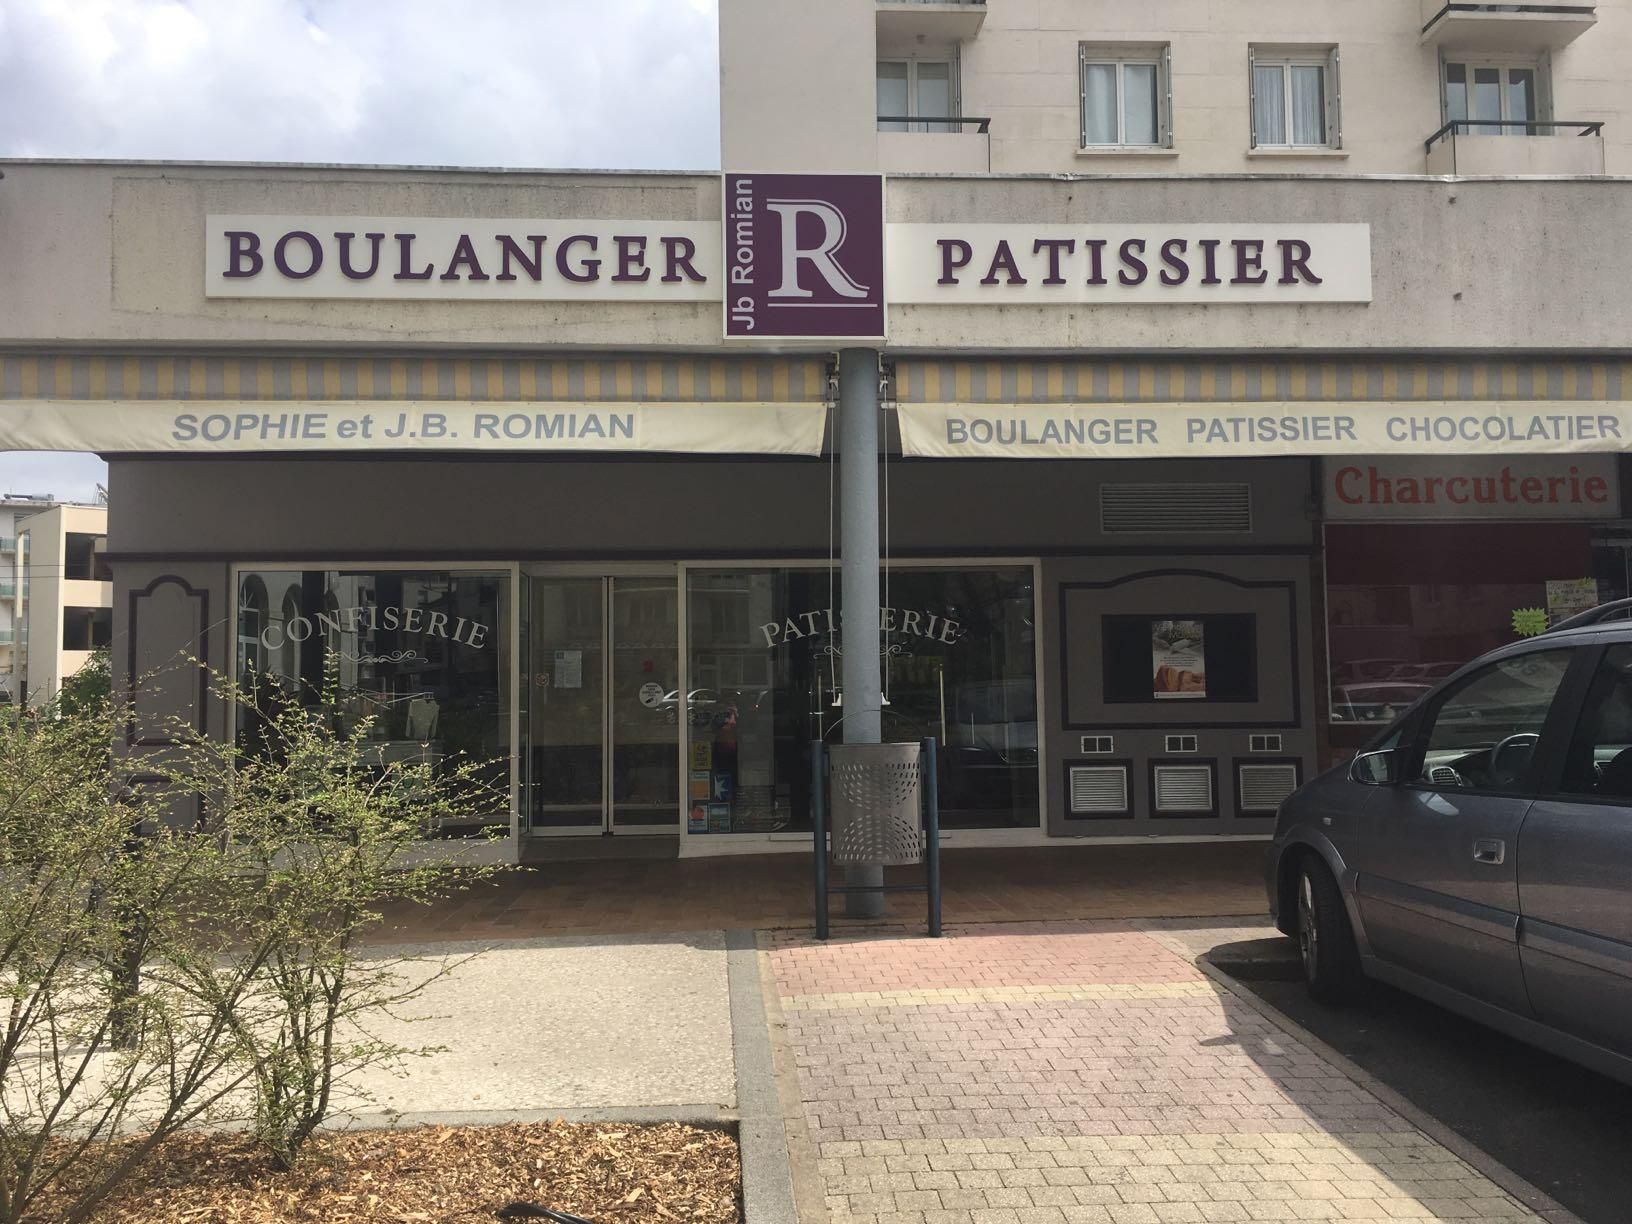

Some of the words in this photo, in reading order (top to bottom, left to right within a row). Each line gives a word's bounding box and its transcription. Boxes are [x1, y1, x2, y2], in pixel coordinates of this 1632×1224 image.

[730, 179, 754, 284] Romian
[766, 198, 870, 298] R
[223, 231, 708, 283] BOULANGER
[936, 239, 1322, 285] PATISSIER
[732, 296, 755, 330] Jb
[172, 413, 329, 441] SOPHIE
[336, 415, 373, 439] et
[384, 414, 458, 438] J.B.
[473, 413, 634, 439] ROMIAN
[946, 419, 1159, 445] BOULANGER
[1186, 415, 1357, 443] PATISSIER
[1385, 414, 1621, 442] CHOCOLATIER
[1335, 466, 1609, 505] Charcuterie
[261, 606, 489, 650] CONFISERIE
[760, 607, 960, 648] PATIERIE
